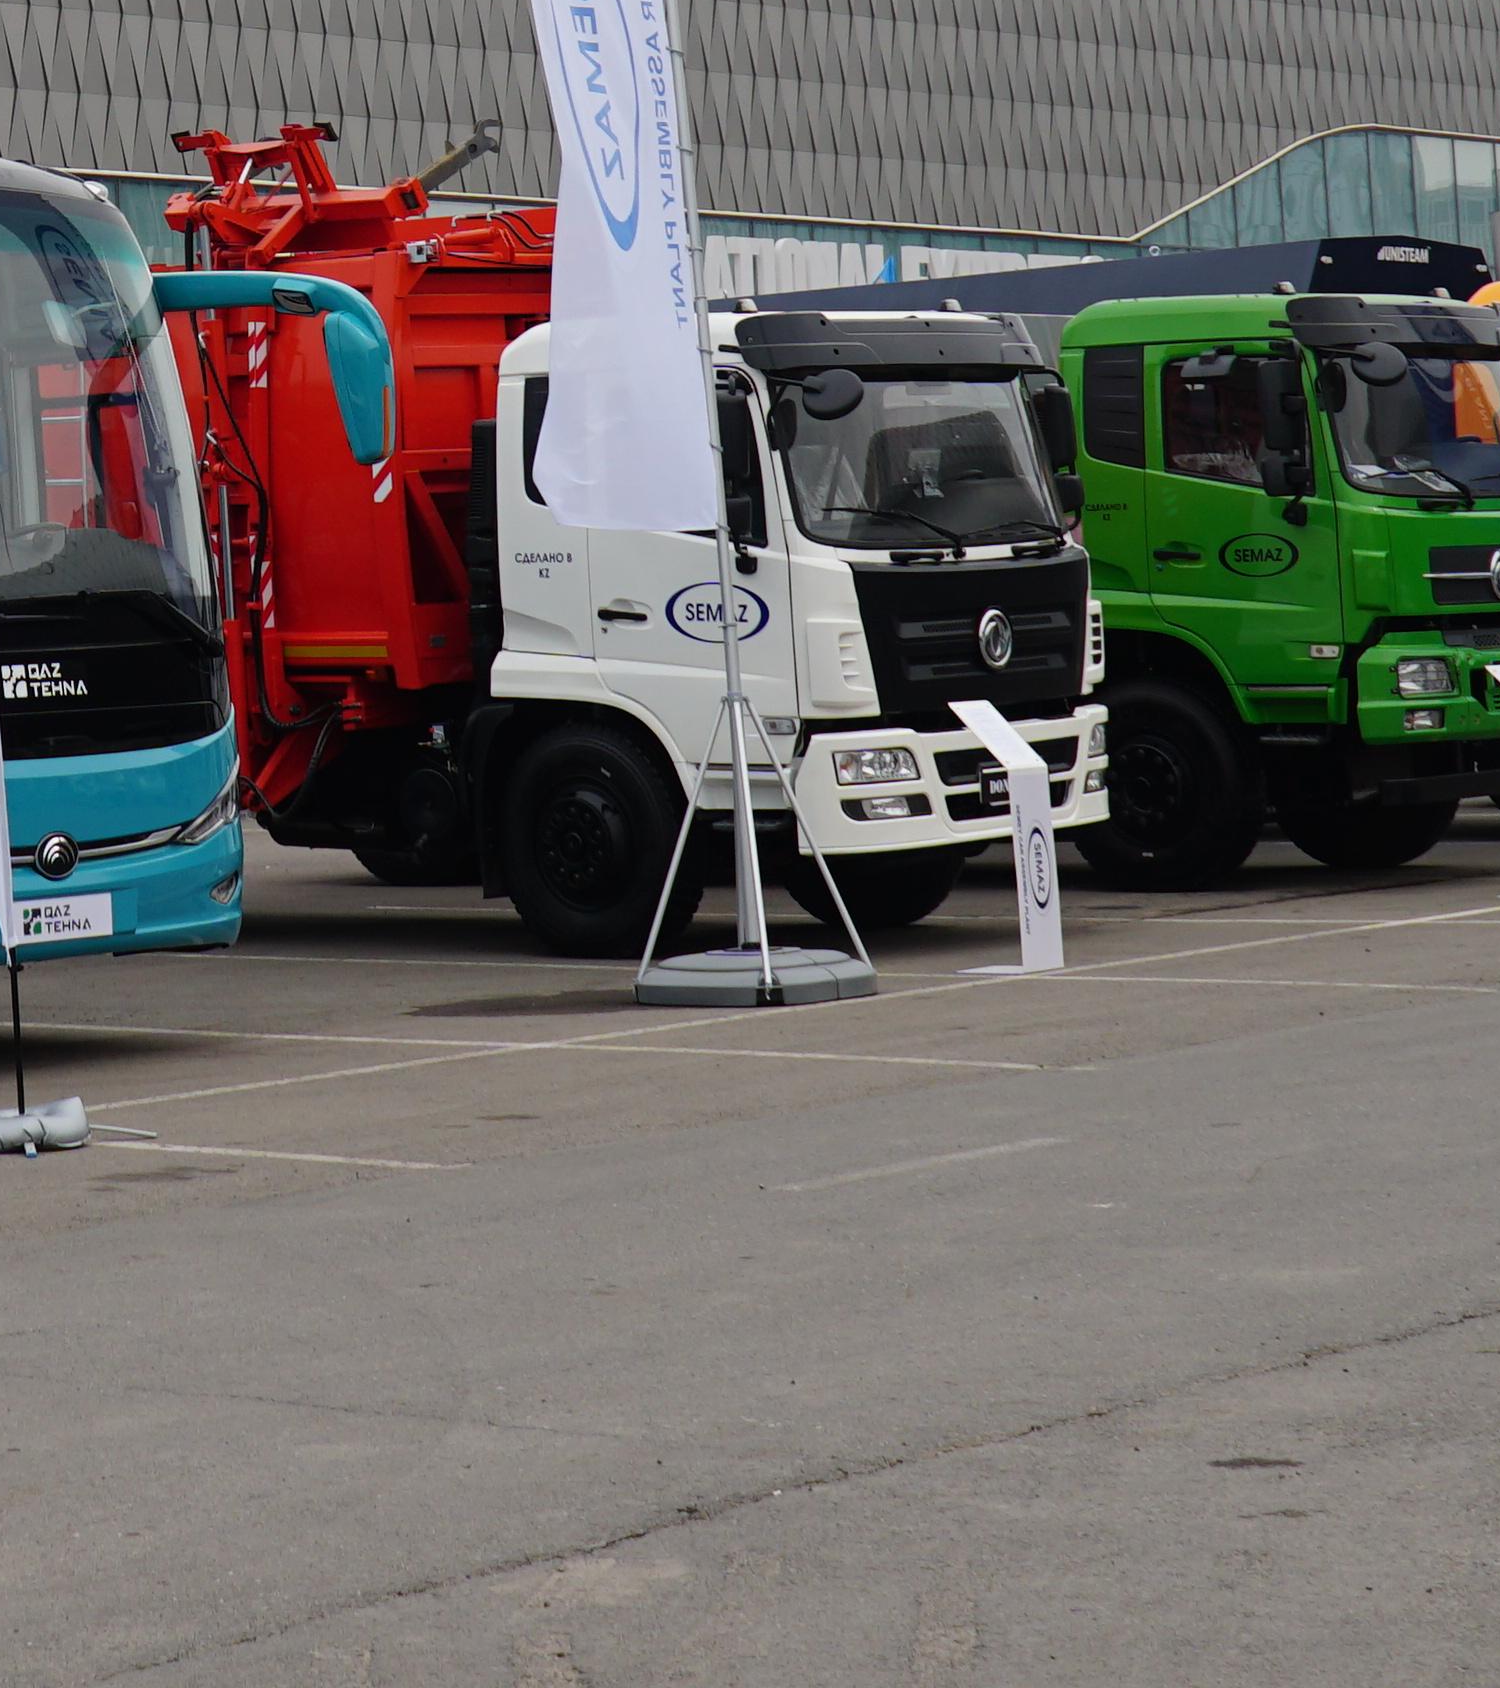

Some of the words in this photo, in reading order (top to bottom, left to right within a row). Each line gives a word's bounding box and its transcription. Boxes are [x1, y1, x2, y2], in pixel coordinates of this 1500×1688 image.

[514, 552, 565, 564] СДЕЛАНО
[1234, 548, 1284, 563] SEMAZ
[538, 568, 550, 579] KZ
[684, 602, 749, 623] SEMZ
[27, 662, 61, 678] QAZ
[29, 679, 88, 697] TEHNA
[1034, 842, 1046, 894] SEMAZ
[44, 904, 71, 919] QAZ
[45, 918, 92, 933] TEHNA
